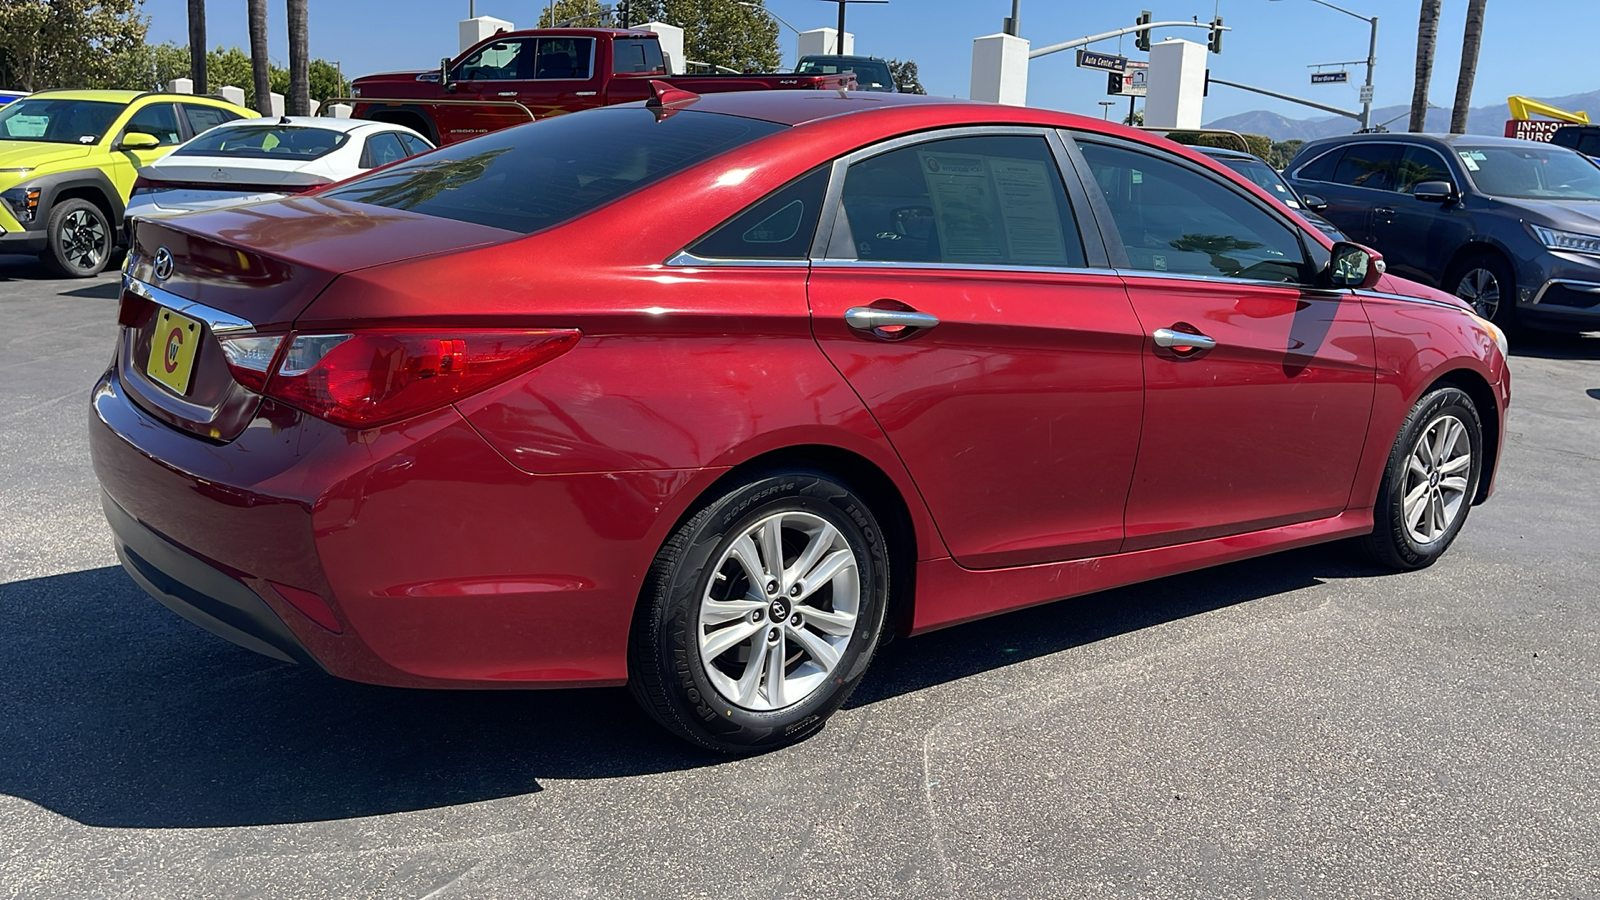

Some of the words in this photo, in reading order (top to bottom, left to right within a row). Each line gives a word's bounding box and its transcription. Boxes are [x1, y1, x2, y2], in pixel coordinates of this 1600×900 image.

[1085, 56, 1096, 65] Auto
[1098, 58, 1113, 67] Center
[723, 482, 795, 525] 205/65R16
[674, 606, 718, 723] IRONMAN
